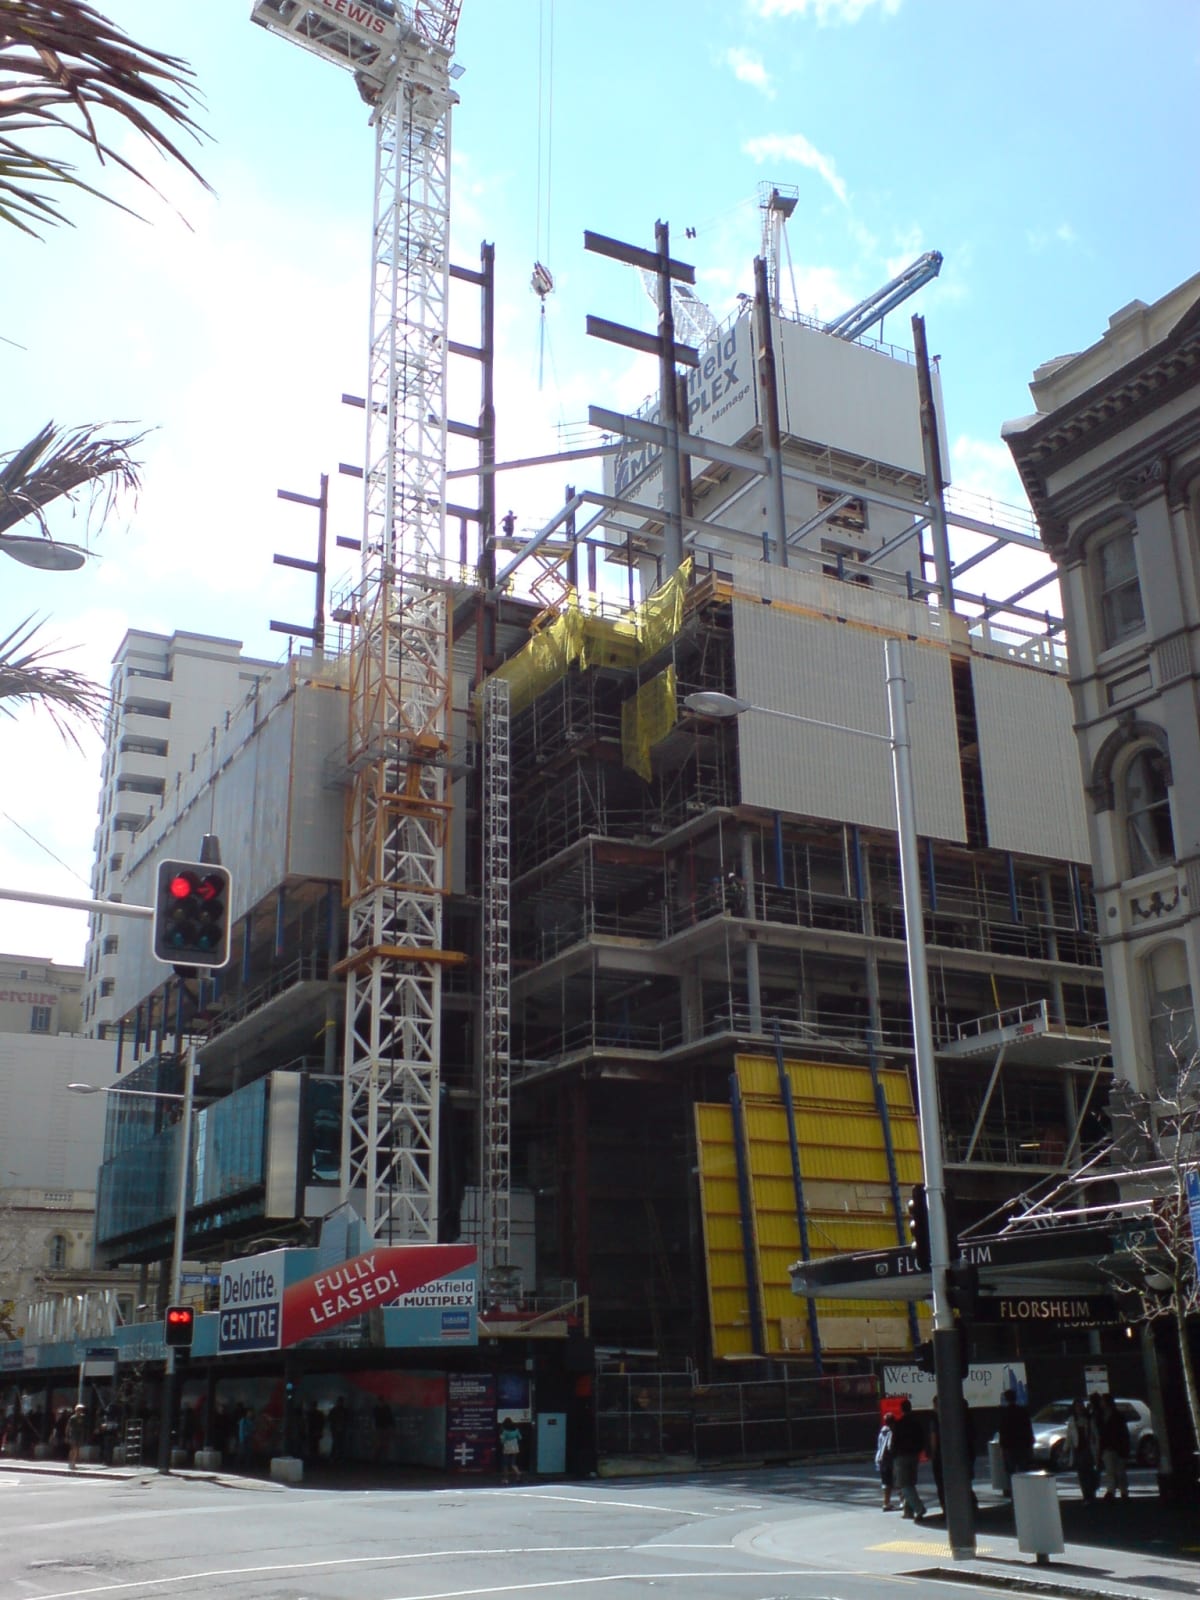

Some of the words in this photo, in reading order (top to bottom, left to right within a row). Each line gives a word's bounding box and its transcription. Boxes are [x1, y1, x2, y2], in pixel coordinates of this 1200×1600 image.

[314, 1255, 377, 1297] FULLY
[310, 1269, 399, 1324] LEASED!
[404, 1295, 473, 1307] MULTIPLEX
[1000, 1300, 1090, 1319] FLORSHEIM
[220, 1308, 276, 1342] CENTRE
[884, 1366, 924, 1384] We're
[970, 1369, 992, 1385] top
